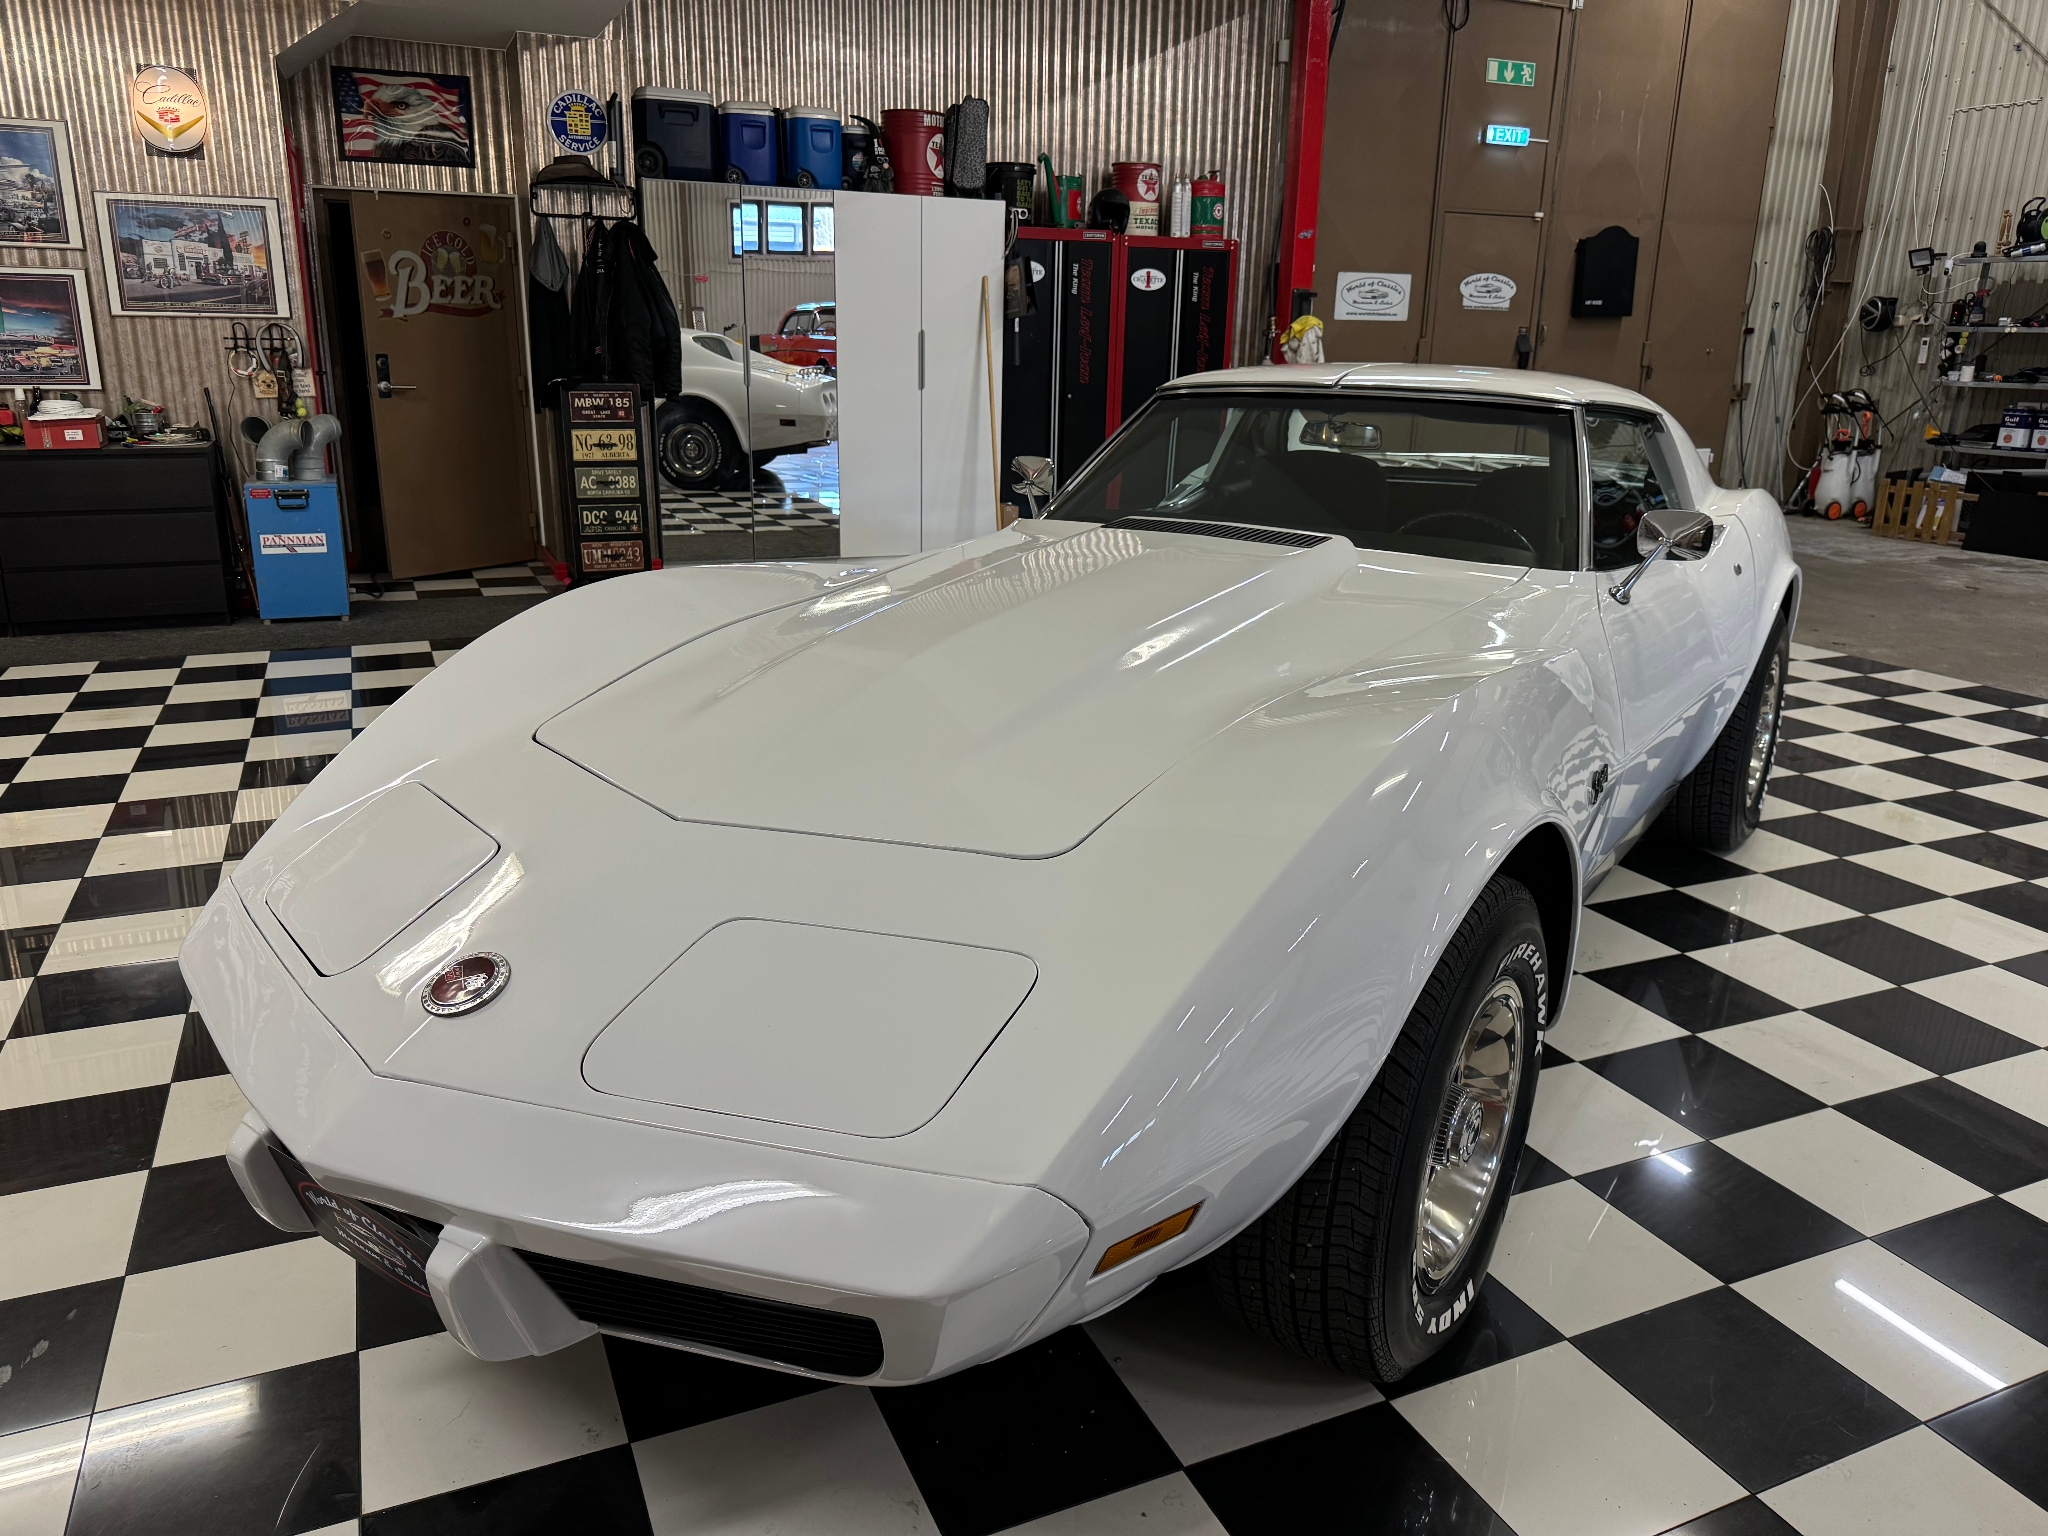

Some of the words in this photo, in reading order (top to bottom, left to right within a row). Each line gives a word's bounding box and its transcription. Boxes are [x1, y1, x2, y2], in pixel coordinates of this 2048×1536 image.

[136, 81, 201, 107] Cadillac
[553, 94, 602, 117] CADILLAC
[923, 113, 944, 128] MOTO
[559, 134, 601, 152] SERVICE
[1495, 128, 1523, 143] EXIT
[1134, 217, 1159, 225] TEXAC
[422, 234, 442, 257] ICE
[446, 232, 476, 265] COLD
[388, 250, 503, 318] BEER
[1071, 278, 1079, 295] King
[1080, 258, 1094, 304] Team
[1200, 266, 1214, 311] Team
[1345, 282, 1366, 293] World
[1376, 280, 1402, 295] Classics
[1463, 276, 1482, 287] World
[1491, 275, 1515, 290] Classics
[1191, 285, 1199, 303] King
[574, 397, 605, 408] MBW
[608, 397, 630, 408] 185
[580, 475, 597, 489] AC
[615, 509, 638, 524] 944
[262, 535, 324, 545] PANNMAN
[305, 1191, 341, 1211] World
[343, 1207, 359, 1222] of
[361, 1216, 426, 1272] Classic
[334, 1226, 383, 1263] Museum
[394, 1268, 429, 1293] Sales
[1427, 1278, 1475, 1334] INDY
